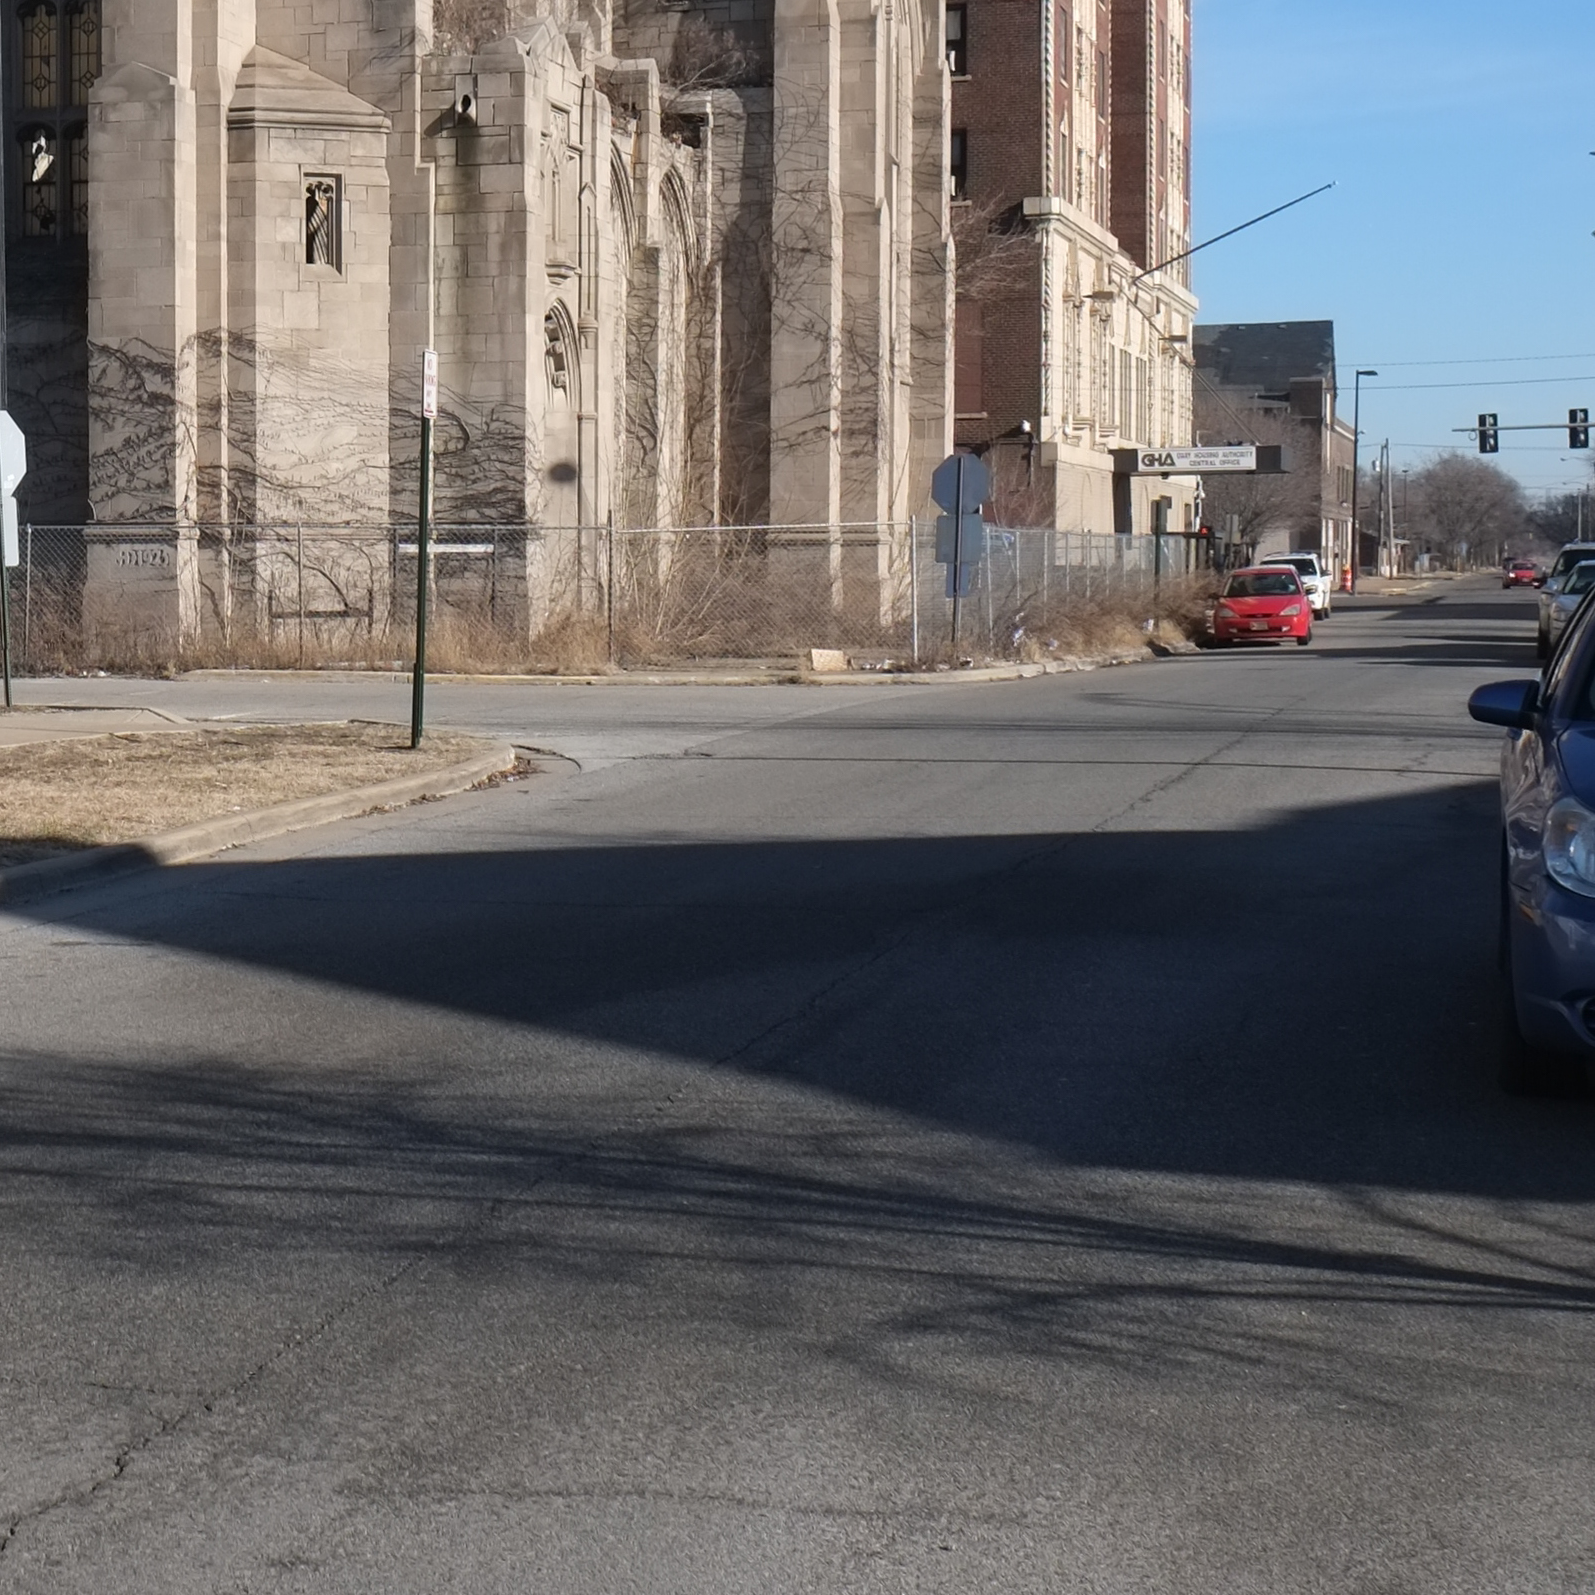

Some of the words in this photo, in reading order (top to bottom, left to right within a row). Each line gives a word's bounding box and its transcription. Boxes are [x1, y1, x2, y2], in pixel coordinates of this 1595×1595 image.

[1194, 451, 1219, 459] HOUSING
[1221, 450, 1253, 459] AUTHORITY
[1141, 452, 1177, 467] GHA
[1189, 459, 1217, 467] CENTRAL
